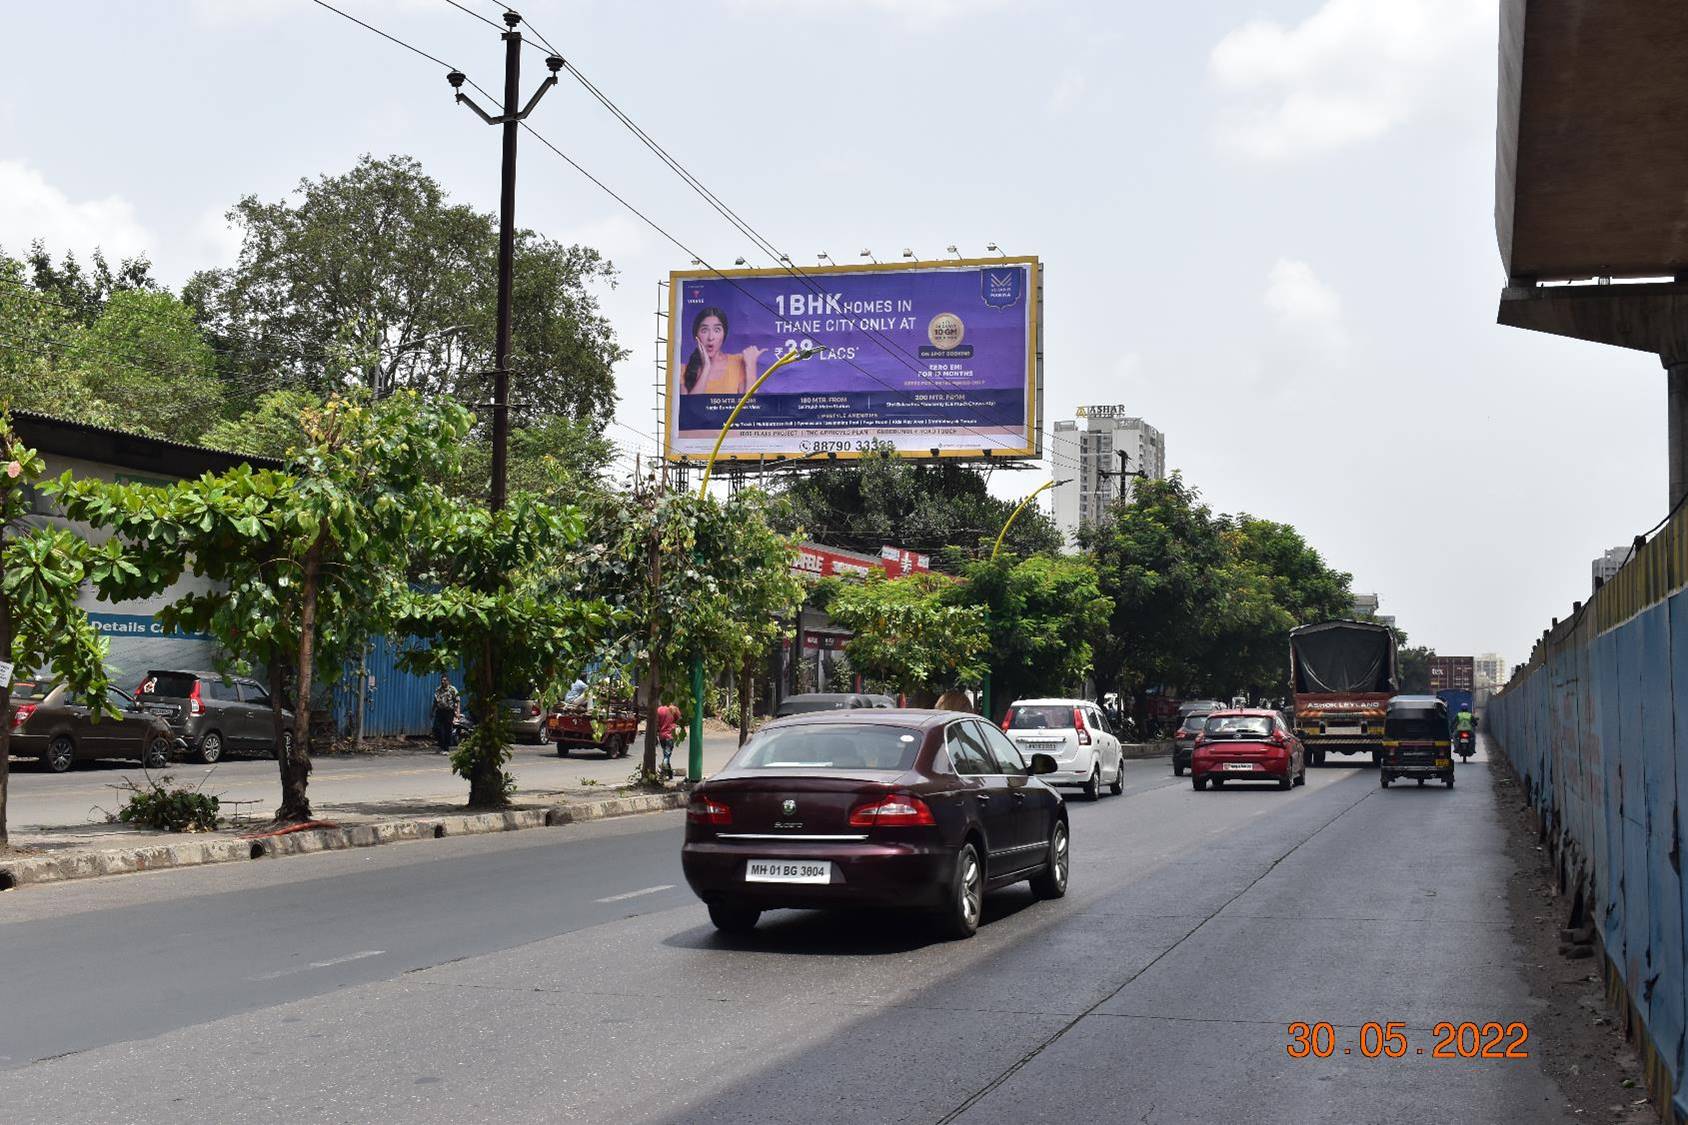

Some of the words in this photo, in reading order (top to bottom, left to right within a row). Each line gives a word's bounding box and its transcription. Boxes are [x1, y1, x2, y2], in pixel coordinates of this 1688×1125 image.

[775, 293, 843, 316] 1BHK
[844, 301, 892, 314] HOMES
[898, 299, 912, 313] IN
[775, 321, 821, 334] THANE
[825, 319, 855, 332] CITY
[860, 317, 896, 331] ONLY
[900, 317, 917, 330] AT
[1090, 404, 1125, 413] ASHAR
[813, 440, 851, 452] 88790
[91, 621, 146, 634] Details
[151, 623, 178, 634] Cal
[1339, 701, 1380, 709] LEYLAND
[751, 864, 767, 875] MH
[769, 865, 781, 876] 01
[783, 865, 798, 876] BG
